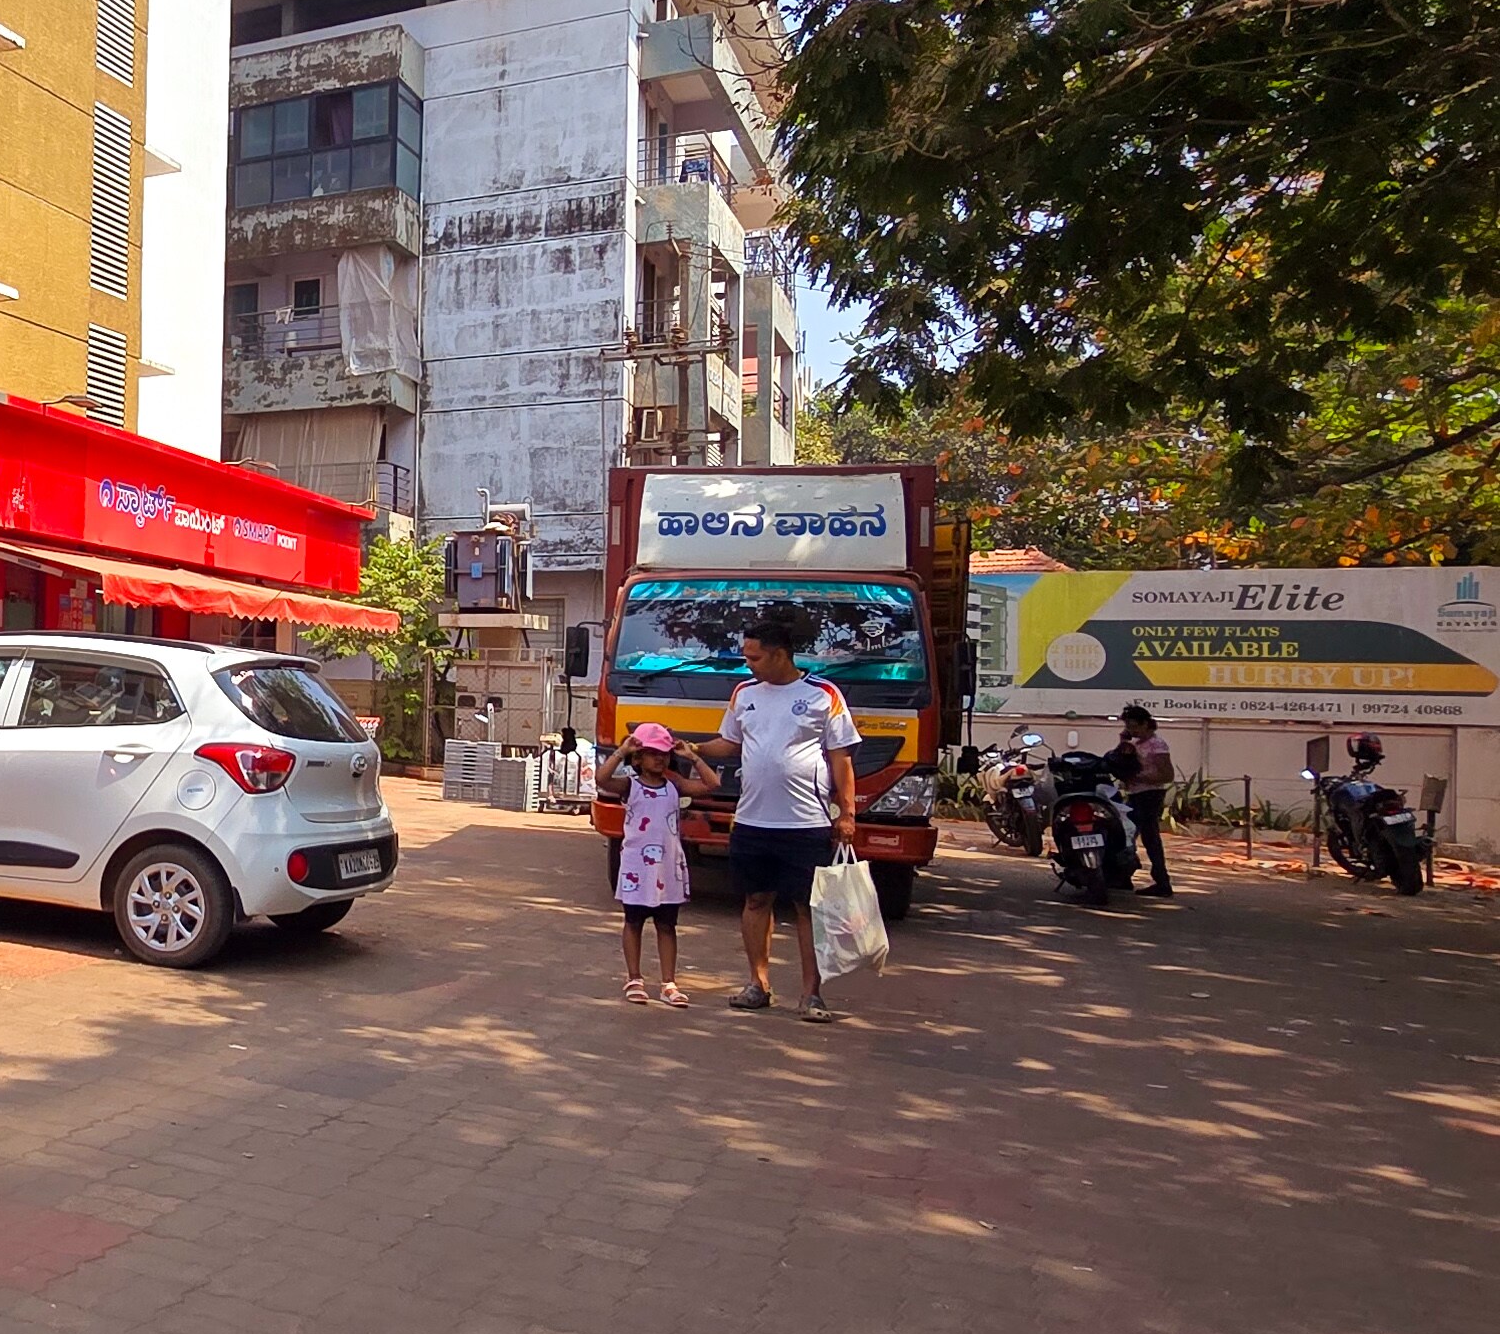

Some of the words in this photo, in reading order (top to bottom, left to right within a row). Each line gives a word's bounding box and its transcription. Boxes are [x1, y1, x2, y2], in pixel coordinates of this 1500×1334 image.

[657, 503, 766, 537] ಹಾಲಿನ
[773, 503, 887, 538] ವಾಹನ
[242, 520, 277, 545] SMART
[277, 533, 298, 551] POINT
[1131, 590, 1235, 604] SOMAYAJI
[1231, 584, 1345, 611] Elite
[1131, 626, 1178, 637] ONLY
[1183, 626, 1220, 637] FEW
[1223, 626, 1281, 637] FLATS
[1131, 640, 1300, 658] AVAILABLE
[1208, 664, 1342, 686] HURRY
[1351, 666, 1416, 688] UP!
[1132, 698, 1159, 709] For
[1164, 699, 1228, 713] Booking
[1240, 701, 1342, 713] 0824-4264471
[1362, 703, 1409, 715] 99724
[1414, 704, 1463, 716] 40868
